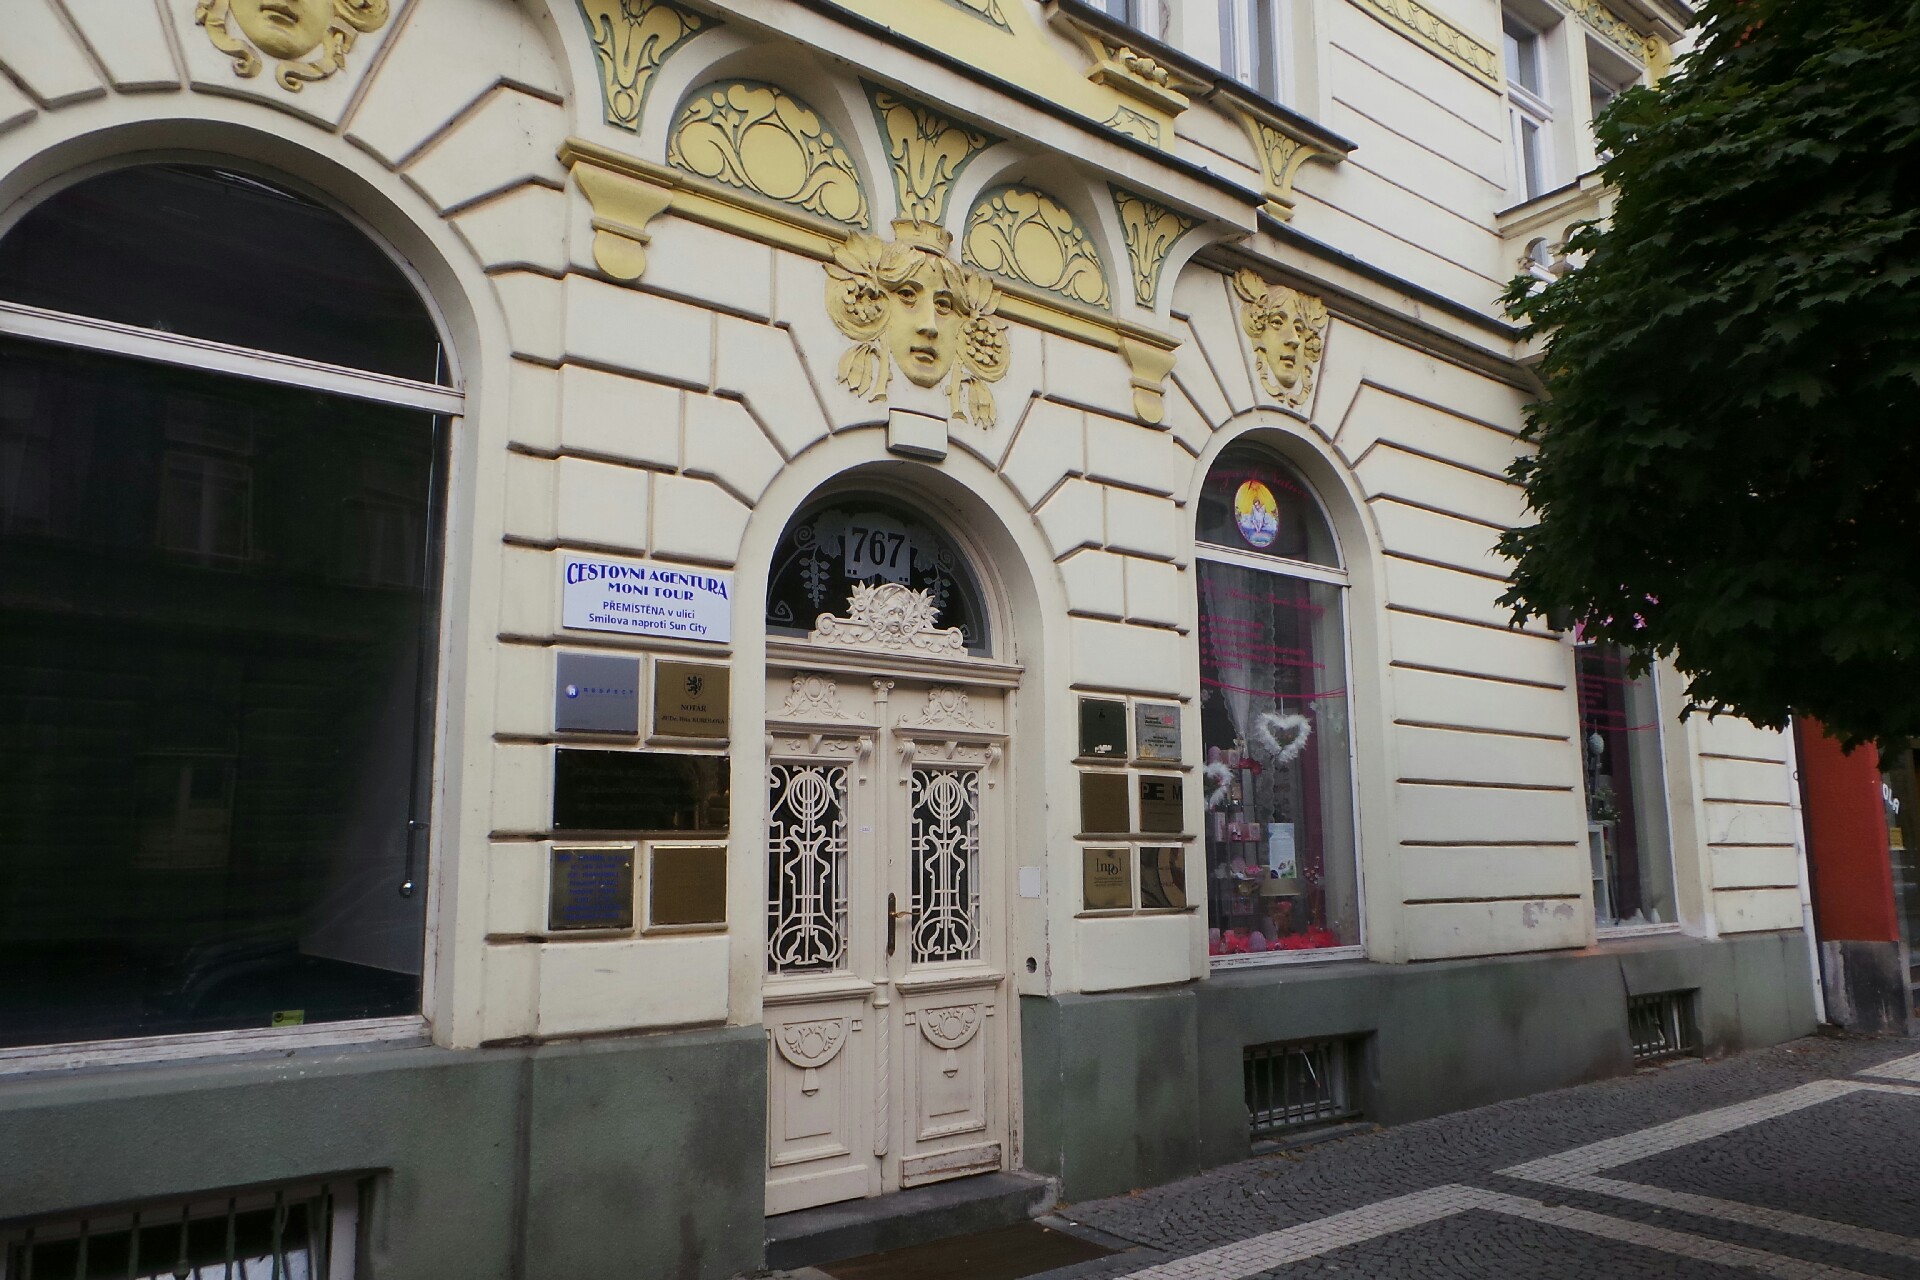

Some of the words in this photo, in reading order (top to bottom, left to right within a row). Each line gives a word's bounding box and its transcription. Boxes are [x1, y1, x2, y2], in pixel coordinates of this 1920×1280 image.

[852, 527, 905, 568] 767
[608, 582, 649, 595] MONI
[653, 587, 694, 600] TOUR
[649, 570, 728, 600] AGENTURA
[589, 613, 629, 626] Smilova
[631, 619, 667, 630] naproti
[669, 621, 687, 631] Sun
[689, 623, 707, 635] City
[668, 609, 674, 617] v
[676, 609, 695, 619] ulici
